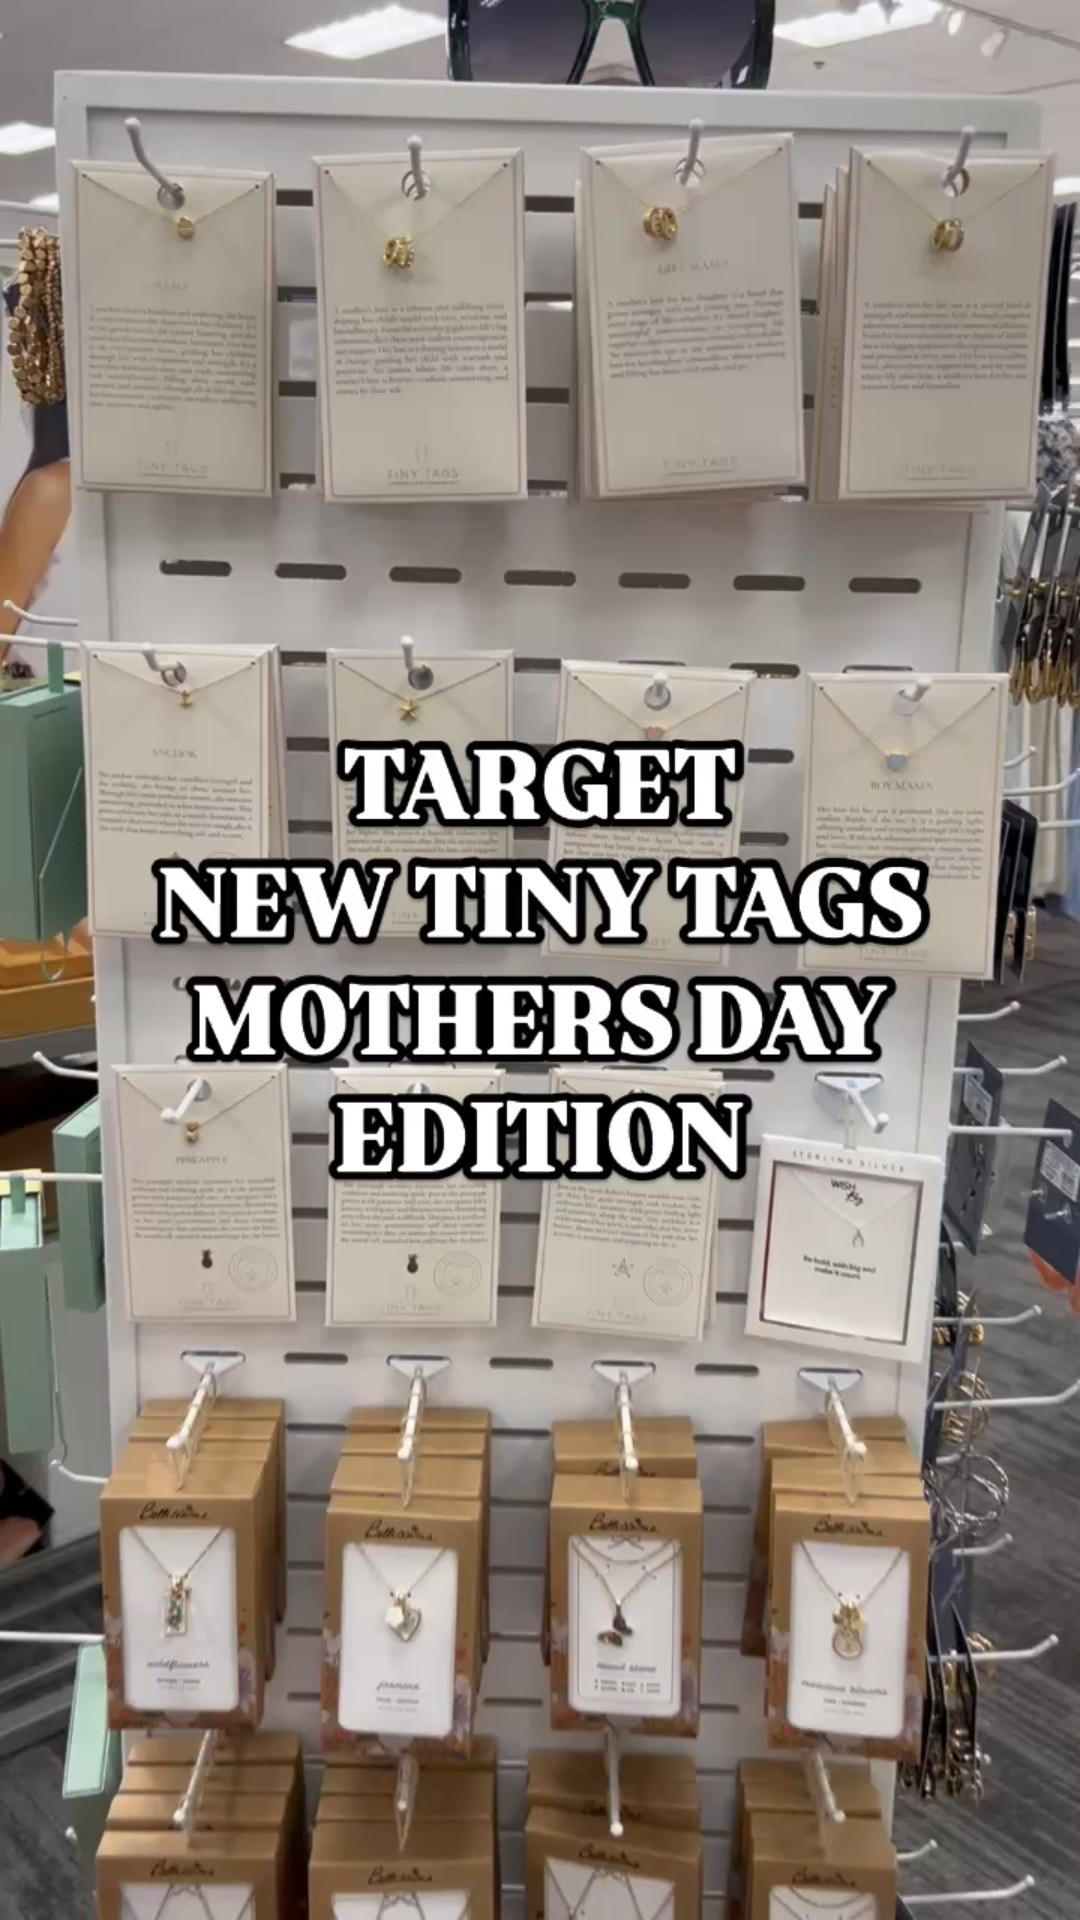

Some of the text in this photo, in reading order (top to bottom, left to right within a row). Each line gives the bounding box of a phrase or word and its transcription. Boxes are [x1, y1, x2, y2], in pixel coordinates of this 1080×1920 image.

[387, 468, 461, 480] TINY TAGS
[176, 1155, 229, 1165] PINEAPPLE
[792, 1150, 905, 1173] STERLING SILVER
[830, 1178, 857, 1192] WISH
